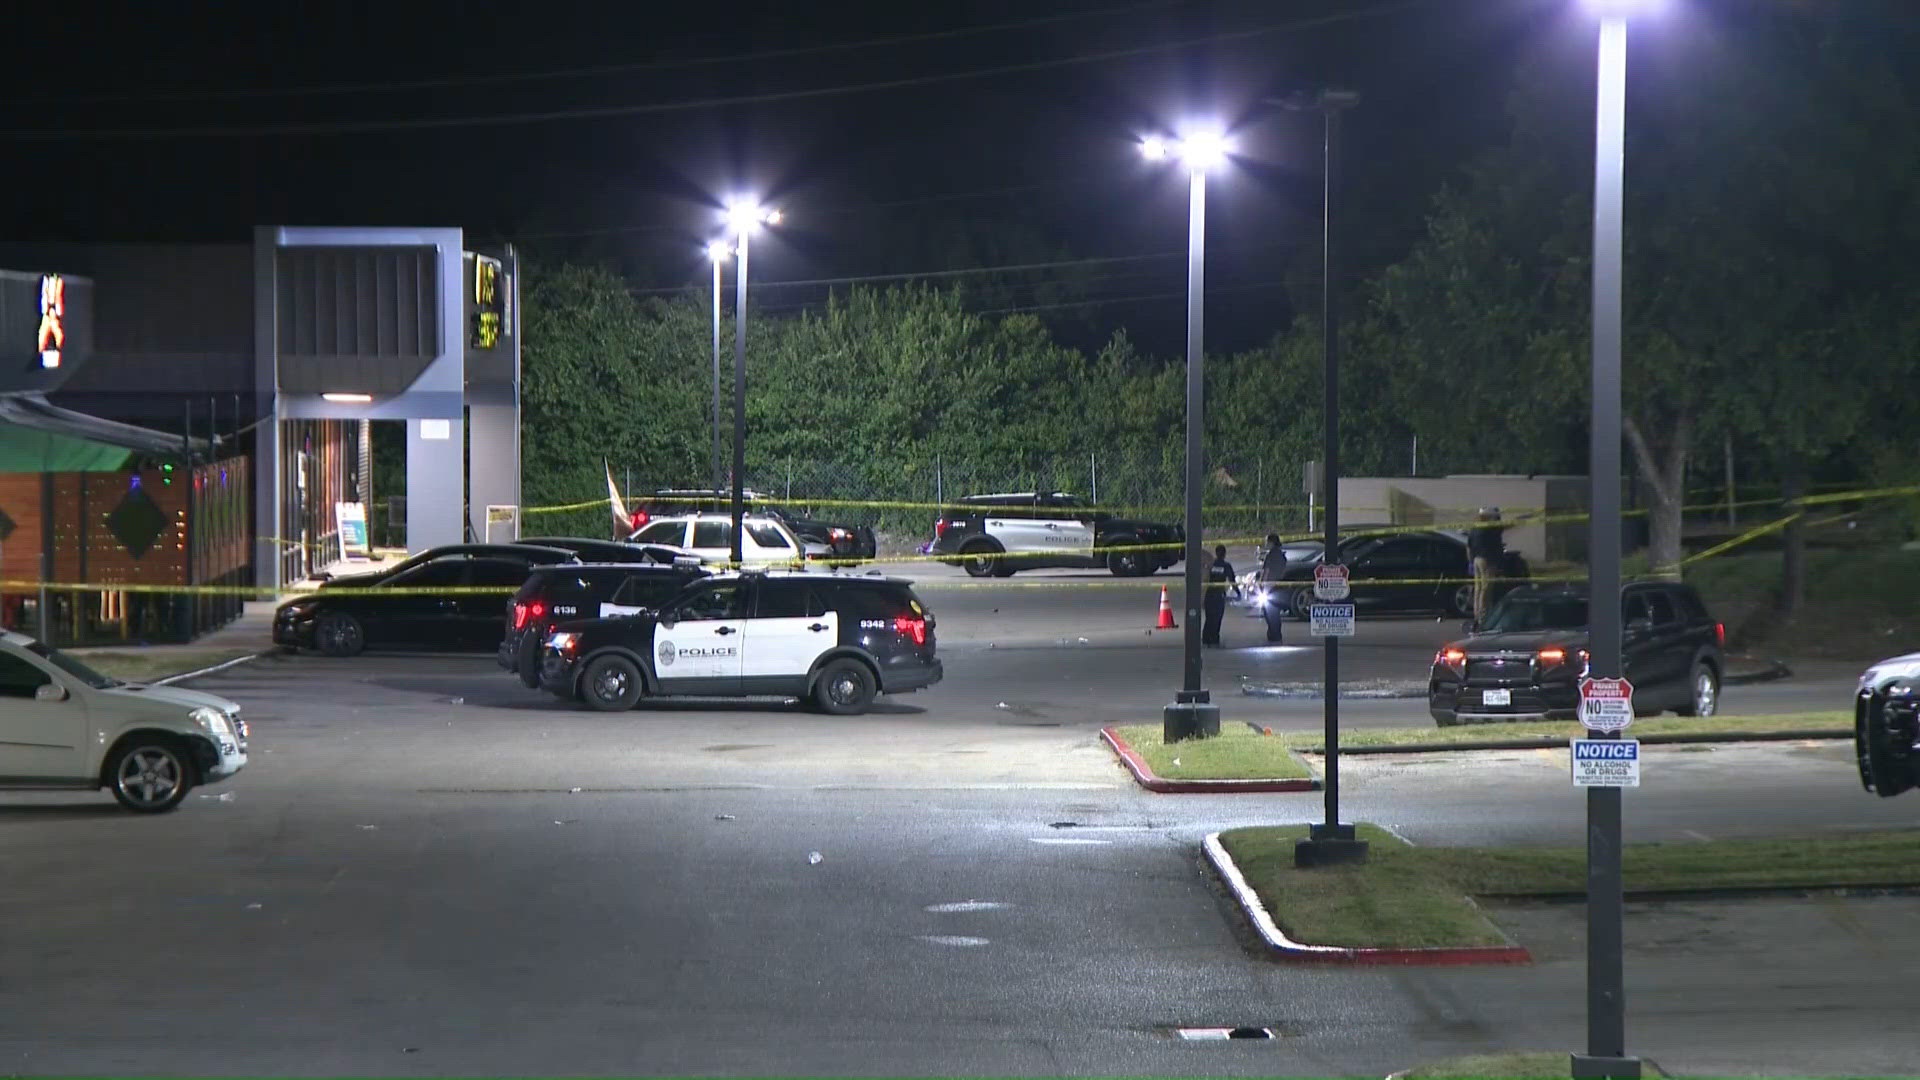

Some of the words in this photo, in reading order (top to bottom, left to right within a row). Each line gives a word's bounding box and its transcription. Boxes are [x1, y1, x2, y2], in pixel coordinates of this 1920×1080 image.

[1045, 535, 1080, 544] POLICE
[1318, 579, 1329, 589] NO
[553, 606, 577, 615] 6136
[1313, 607, 1351, 617] NOTICE
[860, 619, 885, 629] 9342
[678, 647, 737, 656] POLICE
[1592, 682, 1620, 690] PRIVATE
[1588, 689, 1624, 698] PROPERTY
[1586, 699, 1601, 715] NO
[1578, 743, 1635, 758] NOTICE
[1580, 761, 1592, 769] NO
[1594, 761, 1633, 769] ALCOHOL
[1585, 768, 1597, 776] OR
[1599, 768, 1628, 776] DRUGS
